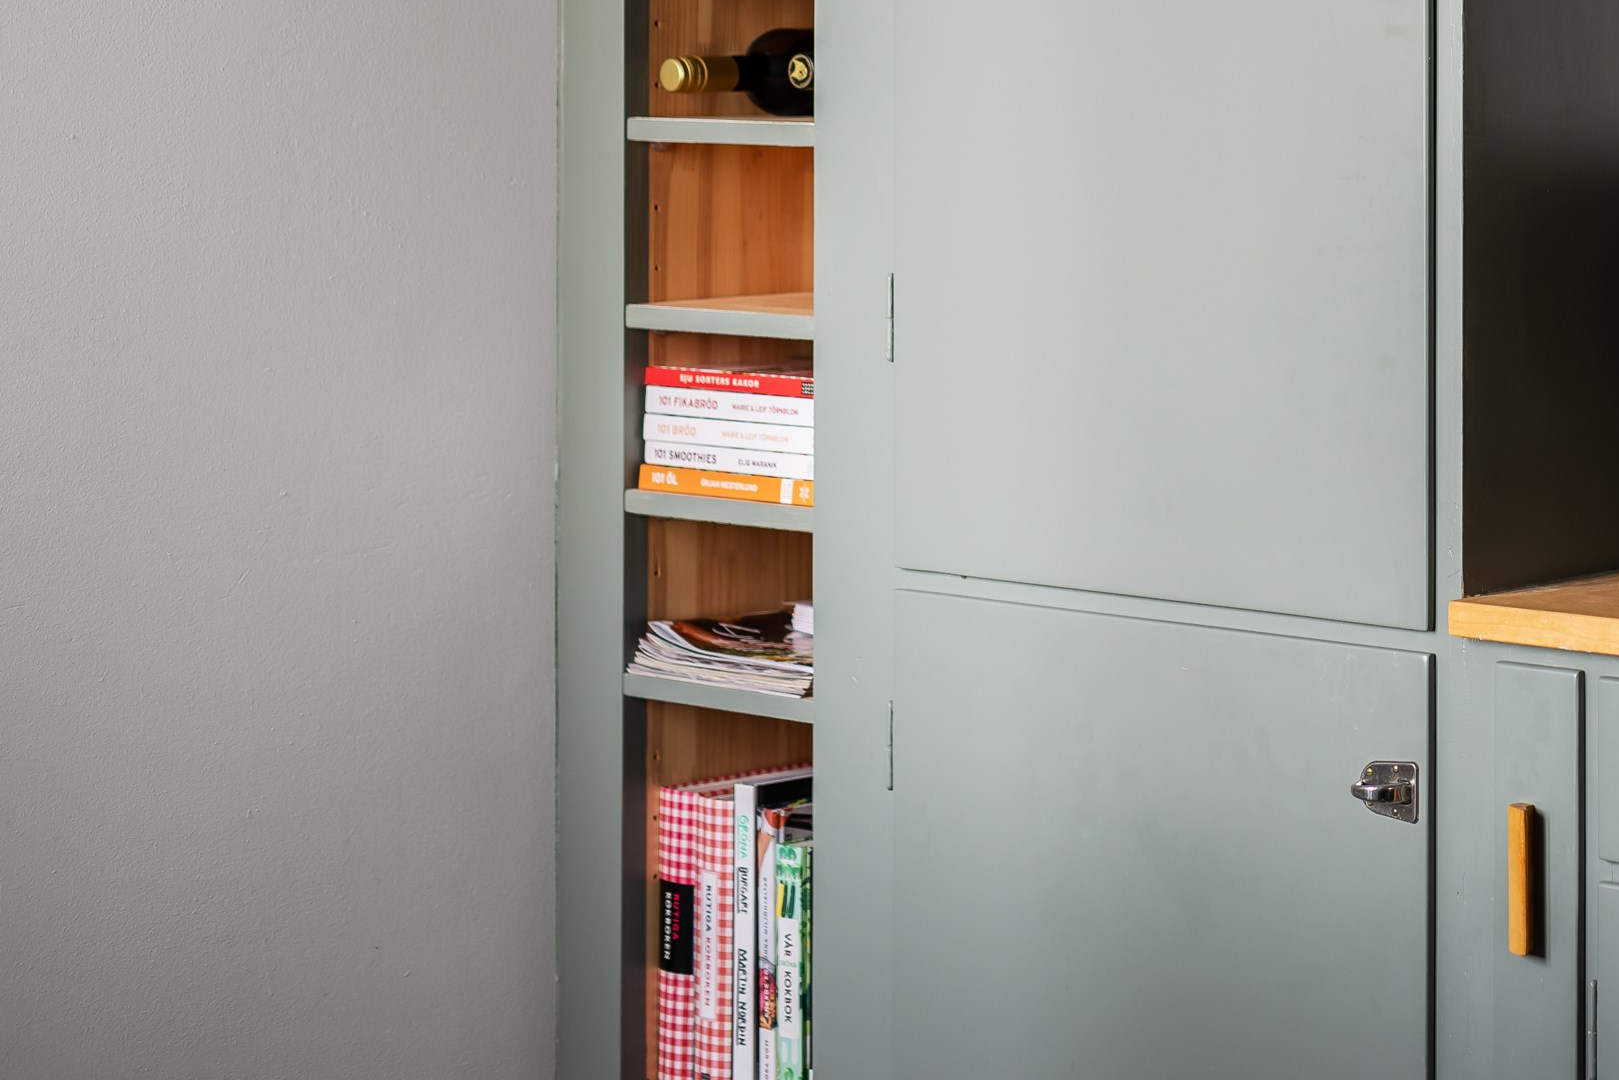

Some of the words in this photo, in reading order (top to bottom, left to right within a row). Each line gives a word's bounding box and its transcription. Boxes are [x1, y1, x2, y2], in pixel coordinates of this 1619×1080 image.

[679, 373, 693, 384] SJU
[695, 374, 730, 386] SORTERS
[732, 378, 760, 389] KAKOR
[659, 395, 671, 406] 101
[674, 396, 719, 410] FIKABRÖD
[732, 403, 749, 411] MARIE
[755, 405, 766, 413] LEIF
[768, 405, 799, 416] TÖRNBLOM
[657, 423, 670, 435] 101
[672, 424, 697, 437] BRÖD
[654, 448, 667, 459] 101
[669, 449, 717, 464] SMOOTHIES
[651, 472, 665, 484] 101
[666, 471, 679, 486] ÖL
[664, 891, 673, 960] KOKBOKEN
[672, 893, 680, 940] RUTIGA
[784, 933, 793, 957] VÅR
[737, 948, 747, 995] MARTIN
[784, 971, 793, 1024] KOKBOK
[737, 1001, 747, 1046] NORDIN
